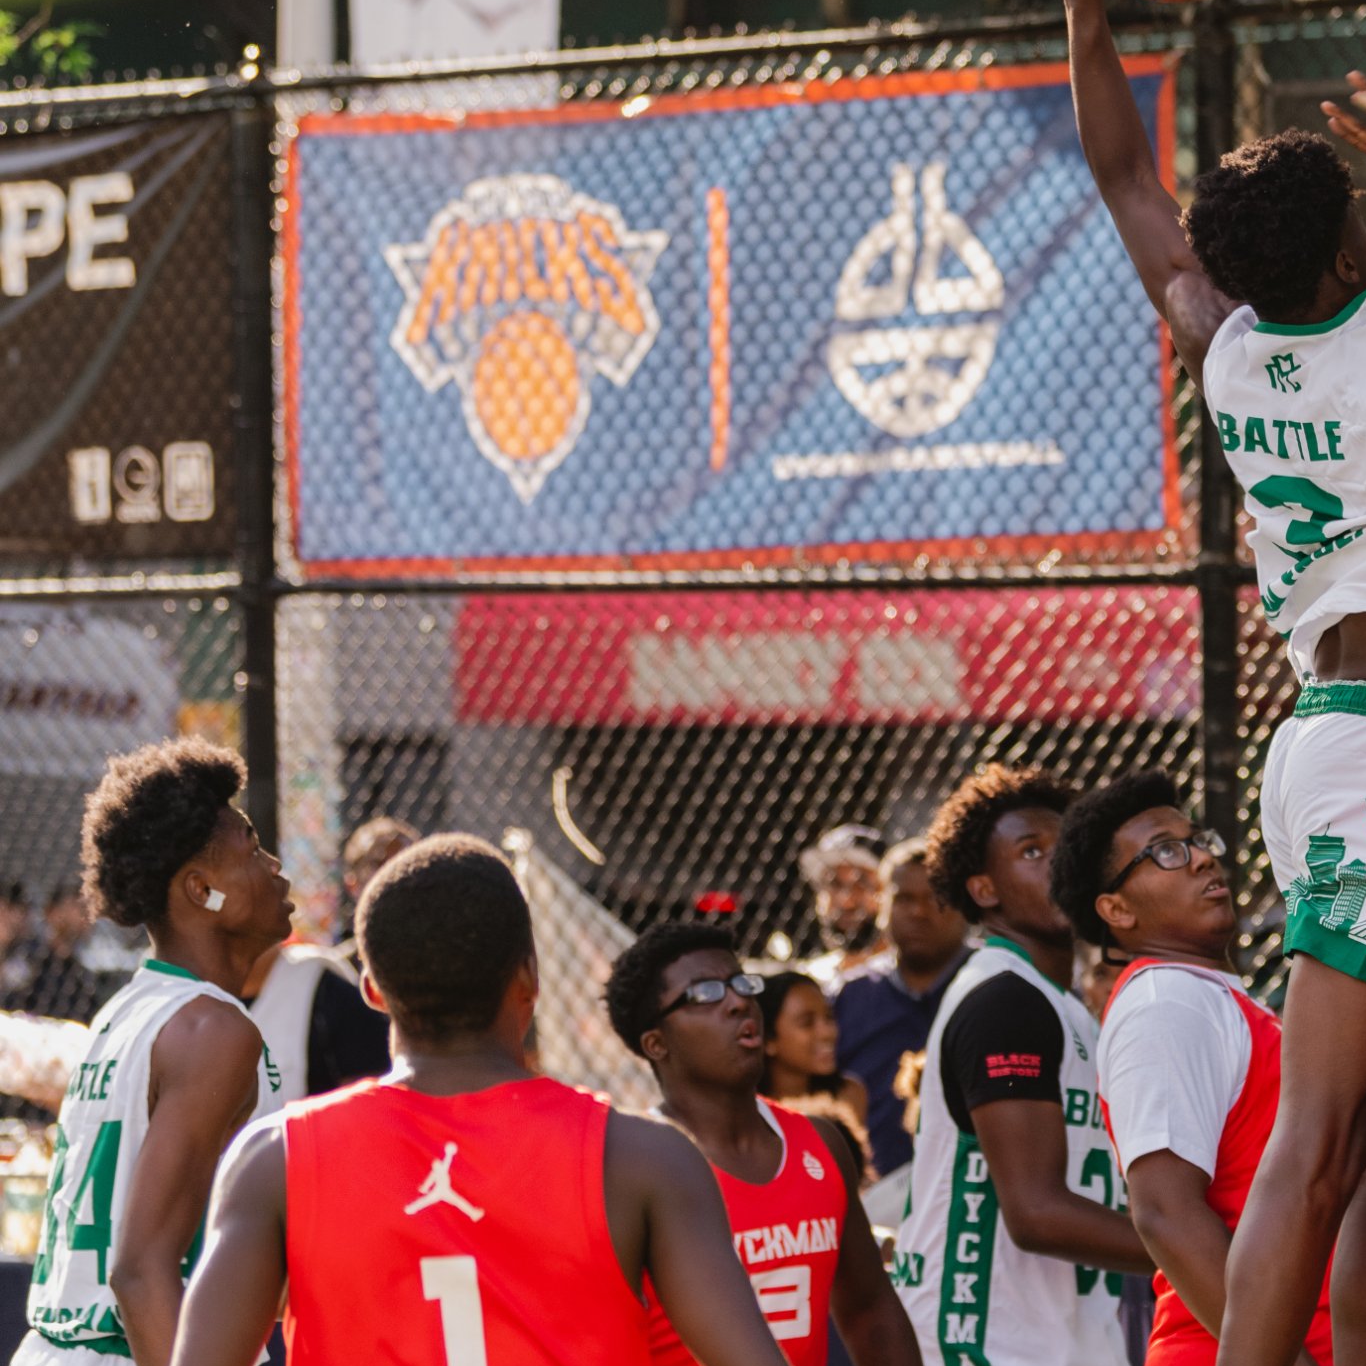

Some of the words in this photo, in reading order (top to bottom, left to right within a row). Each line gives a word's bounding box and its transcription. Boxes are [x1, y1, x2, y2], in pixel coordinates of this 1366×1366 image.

[1216, 410, 1345, 462] BATTLE
[986, 1053, 1041, 1068] BLACK
[987, 1066, 1041, 1078] HISTORY
[750, 1265, 811, 1340] 3
